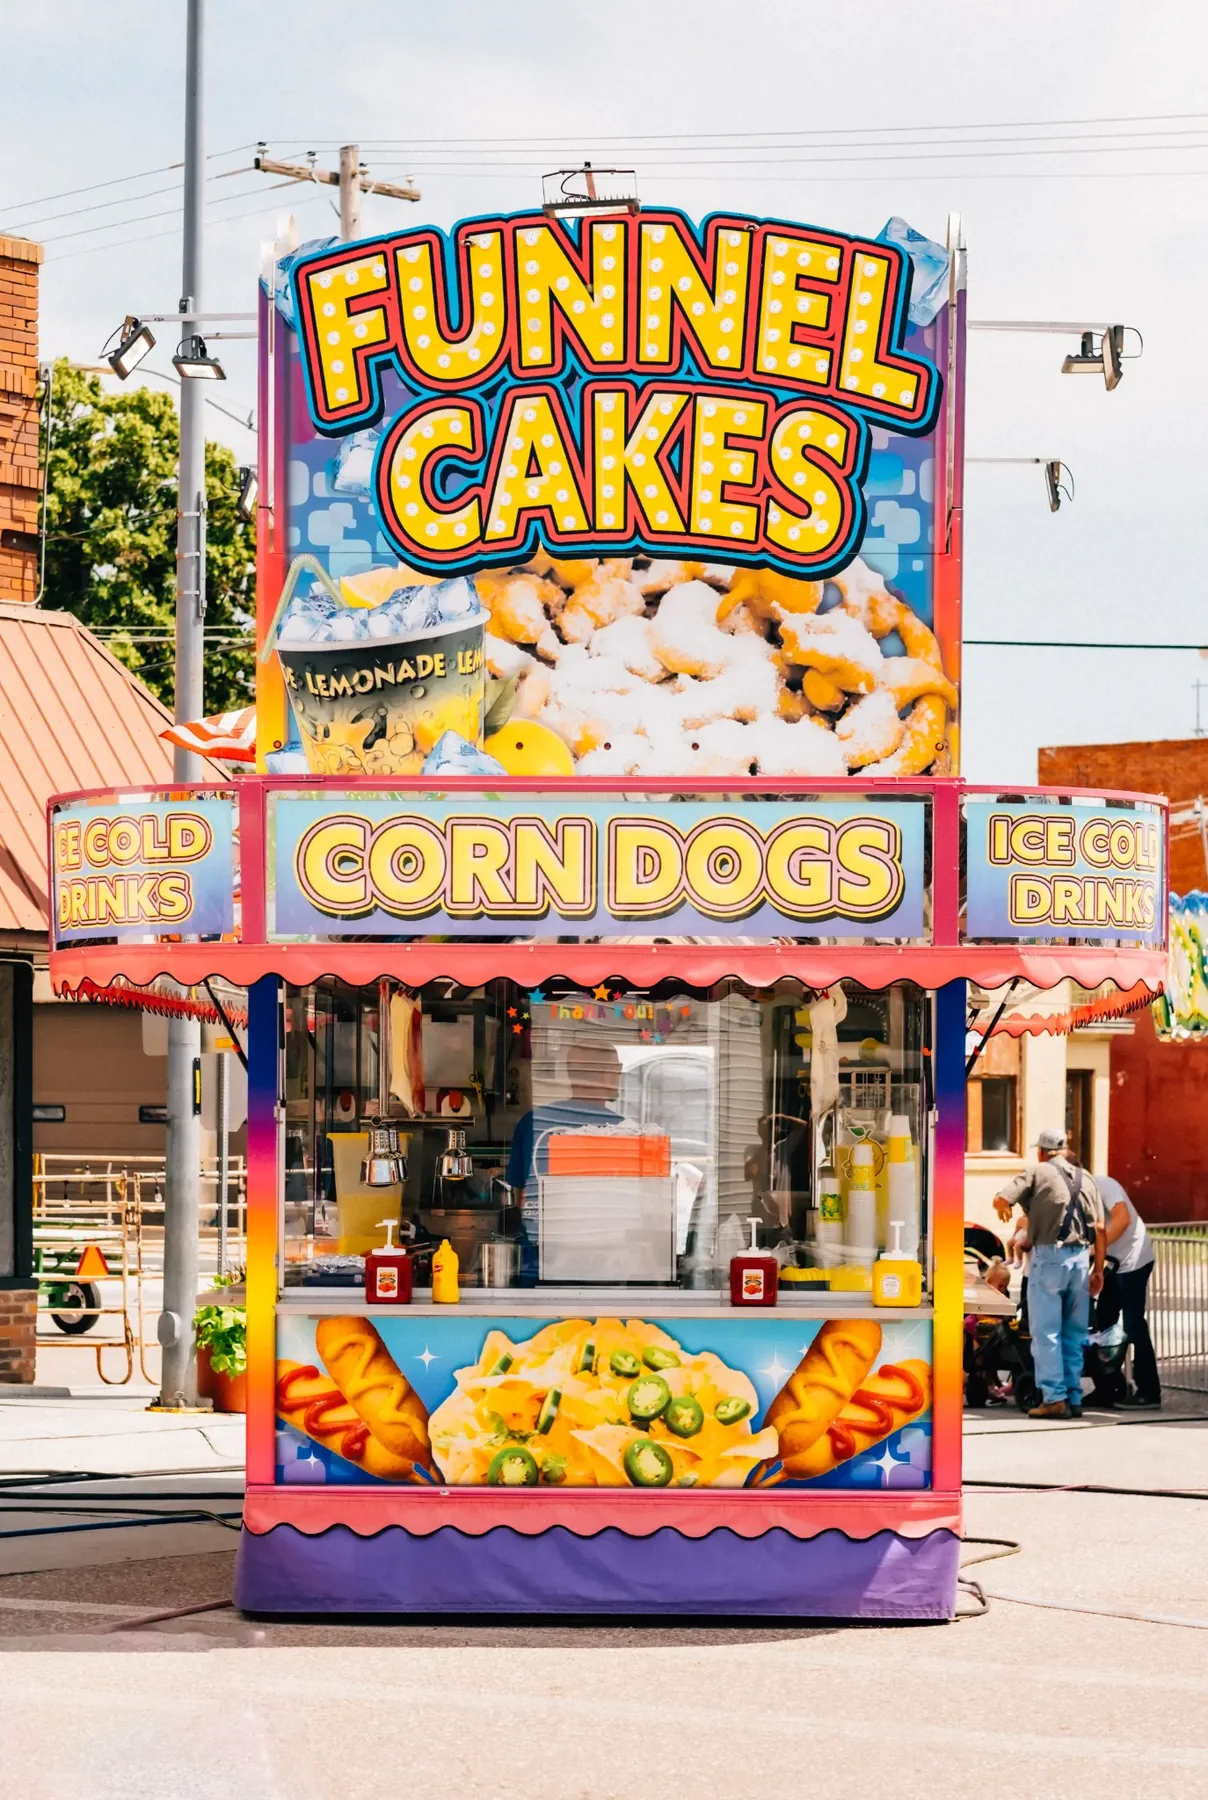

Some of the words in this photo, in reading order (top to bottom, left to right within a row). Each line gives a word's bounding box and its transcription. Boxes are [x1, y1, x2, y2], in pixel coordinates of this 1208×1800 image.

[298, 212, 932, 425] FUNNEL
[378, 384, 862, 566] CAKES
[305, 652, 446, 699] LEMONADE
[56, 822, 83, 871] CE
[85, 812, 211, 866] COLD
[297, 817, 595, 915] CORN
[606, 817, 901, 915] DOGS
[989, 815, 1075, 865] ICE
[59, 871, 194, 930] DRINKS
[1010, 874, 1155, 928] DRINKS
